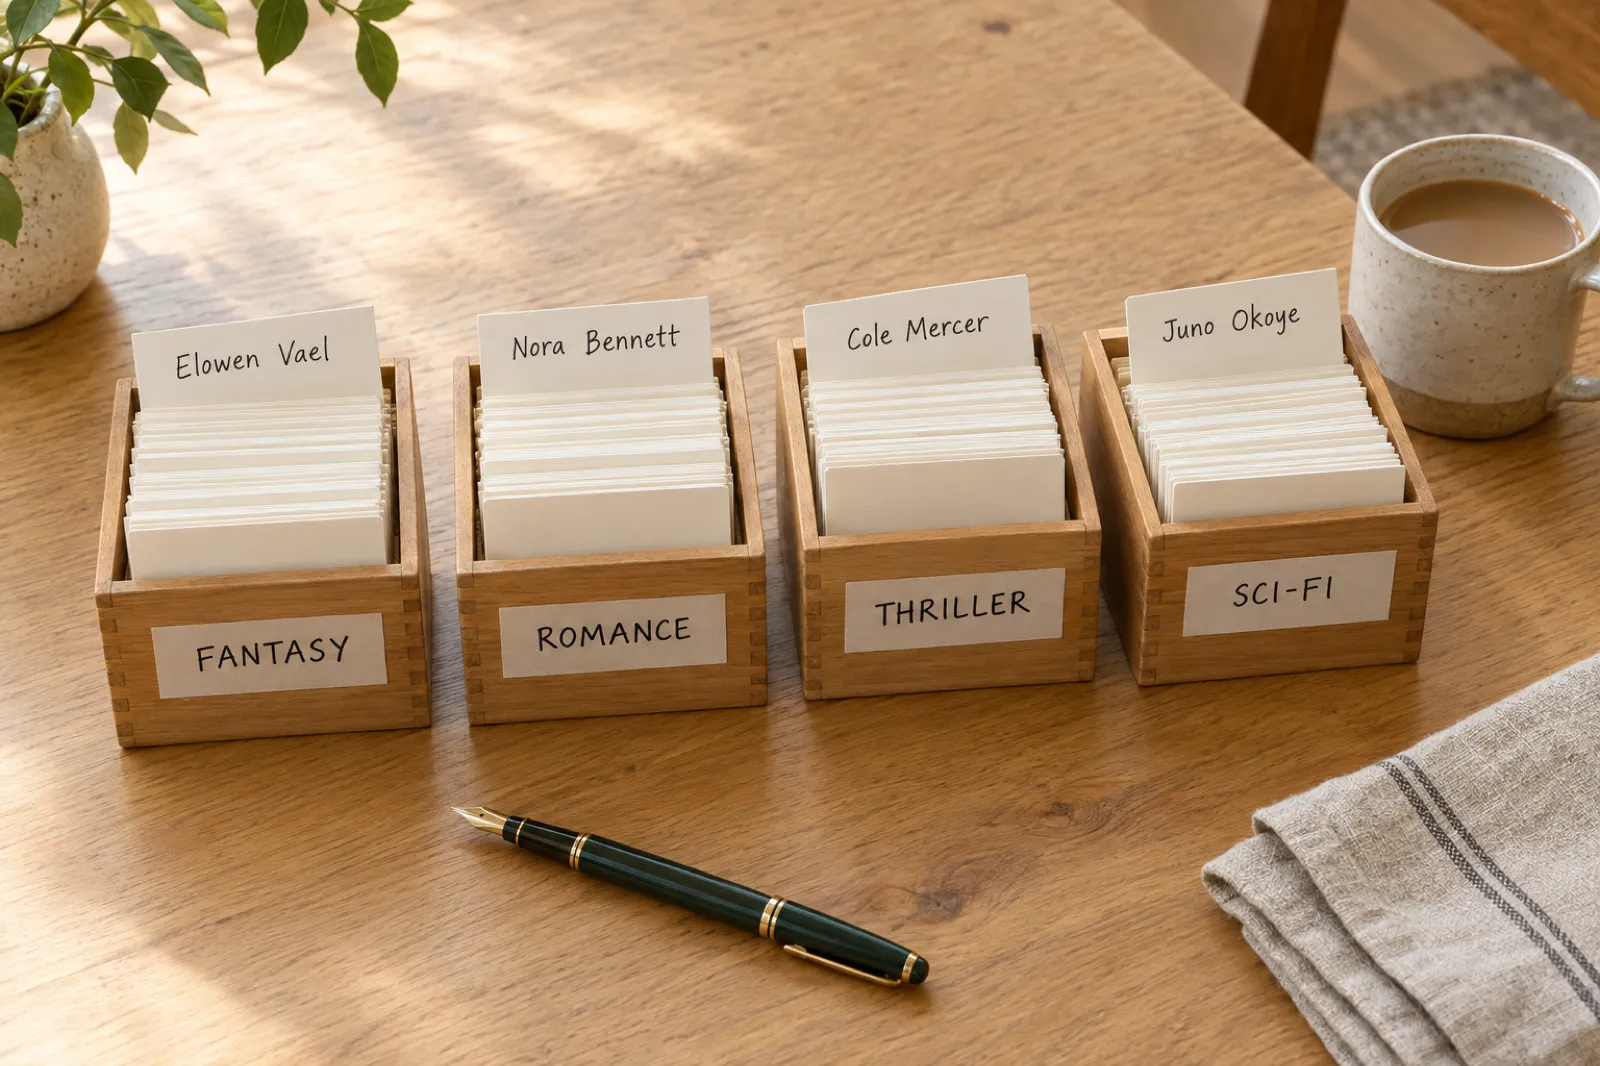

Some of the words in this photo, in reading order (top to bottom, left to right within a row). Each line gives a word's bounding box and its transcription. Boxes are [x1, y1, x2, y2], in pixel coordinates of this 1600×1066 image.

[848, 322, 892, 350] Cole
[906, 316, 989, 342] Mercer
[1163, 319, 1214, 342] Juno
[1232, 303, 1300, 335] Okoye
[177, 352, 259, 379] Elowen
[278, 335, 329, 365] Vael
[513, 336, 565, 360] Nora
[586, 324, 680, 355] Bennett
[875, 591, 1031, 628] THRILLER
[1234, 576, 1332, 607] SCI-FI
[537, 617, 691, 651] ROMANCE
[197, 636, 349, 672] FANTASY
